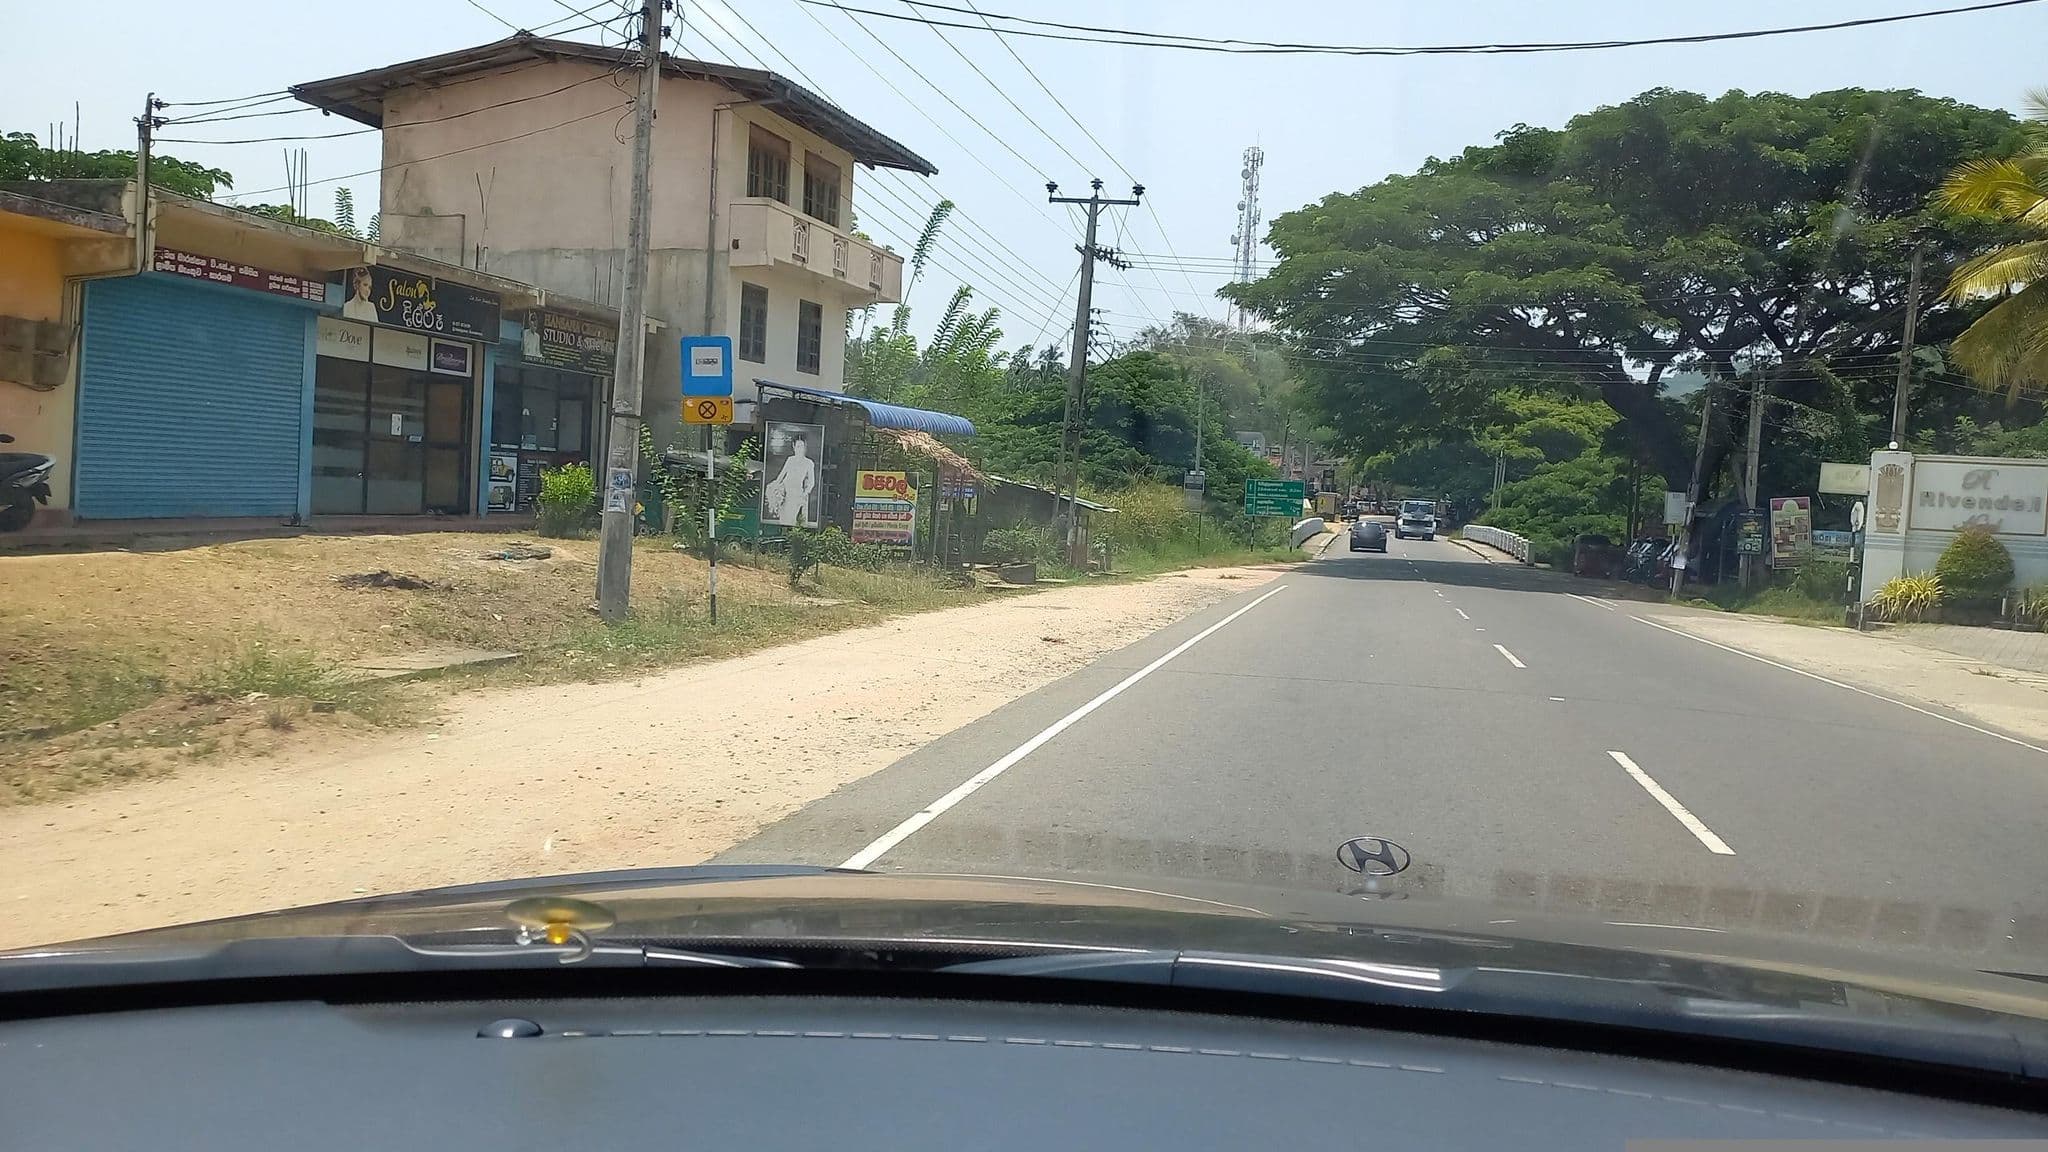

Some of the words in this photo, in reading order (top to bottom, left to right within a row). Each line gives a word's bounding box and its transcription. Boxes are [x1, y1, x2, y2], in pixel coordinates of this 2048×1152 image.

[380, 278, 417, 312] Salon
[339, 329, 363, 346] Dove
[543, 328, 576, 346] STUDIO
